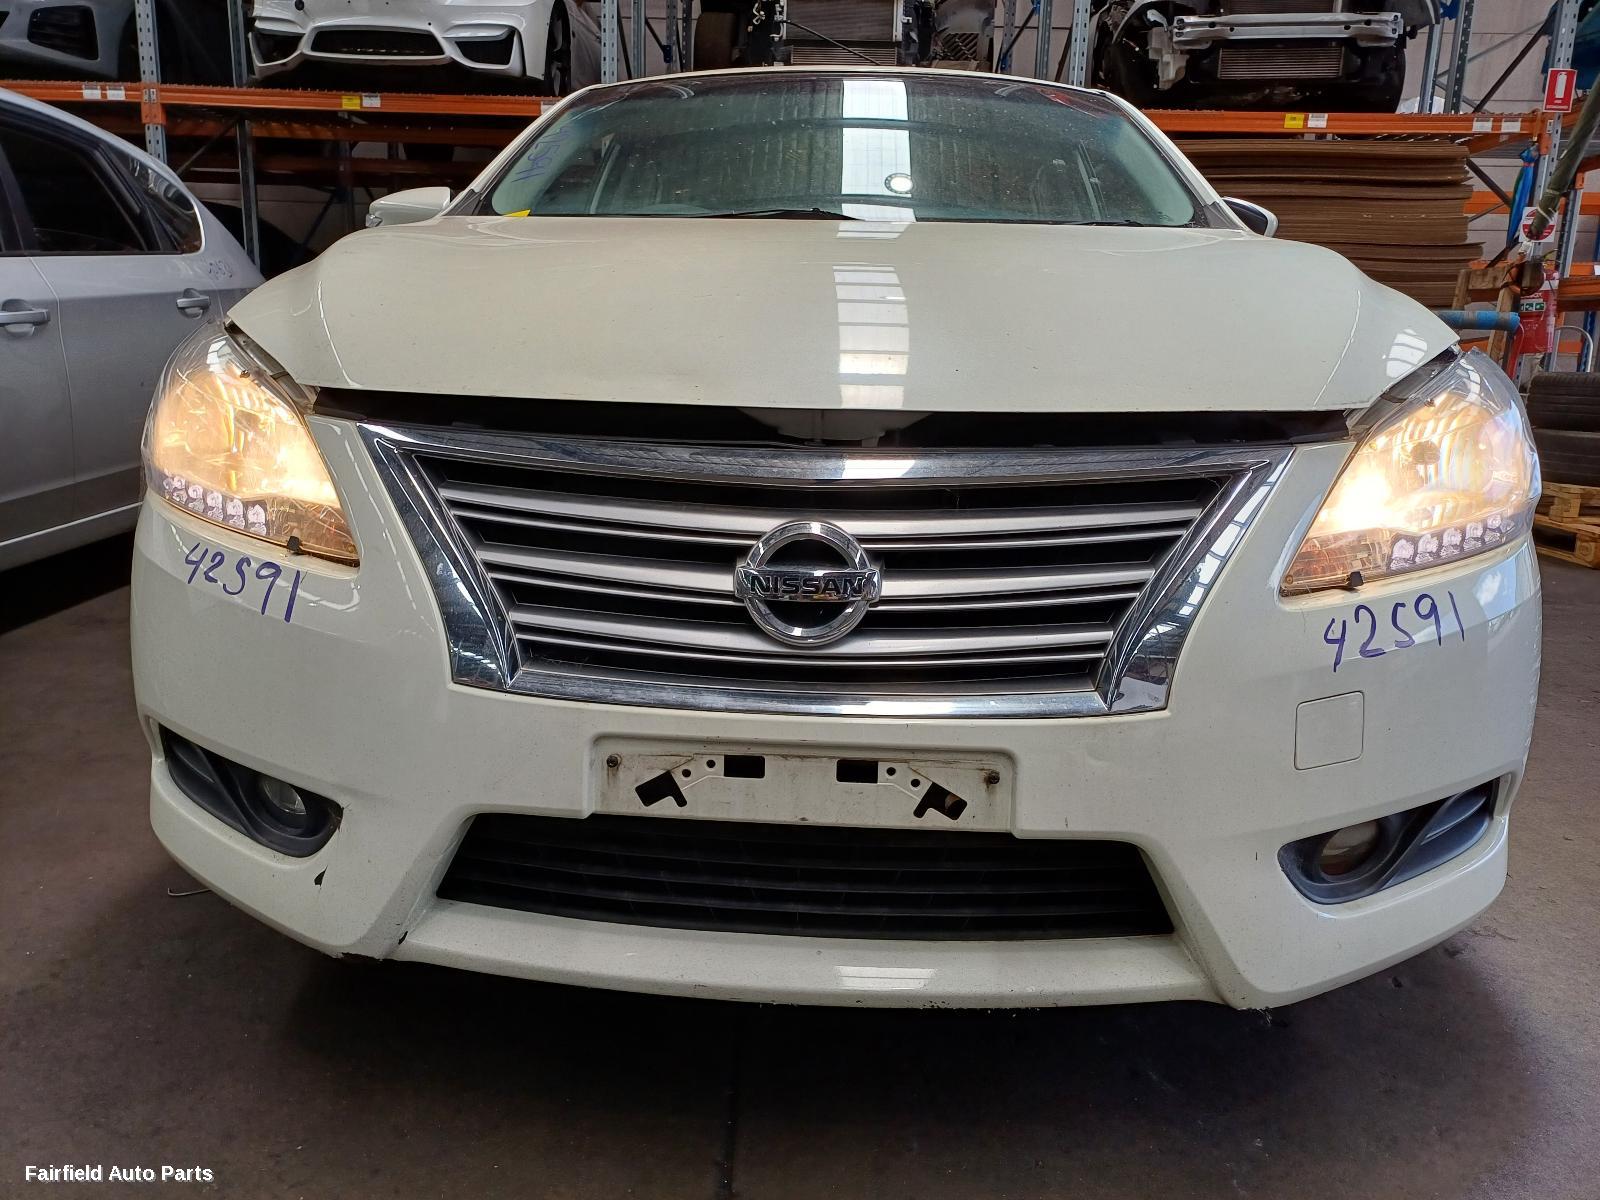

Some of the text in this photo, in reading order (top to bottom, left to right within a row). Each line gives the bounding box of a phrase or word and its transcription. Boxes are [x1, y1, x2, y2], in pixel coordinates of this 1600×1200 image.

[184, 542, 301, 623] 42591
[749, 574, 864, 597] NISSAN
[1323, 590, 1465, 673] 42591
